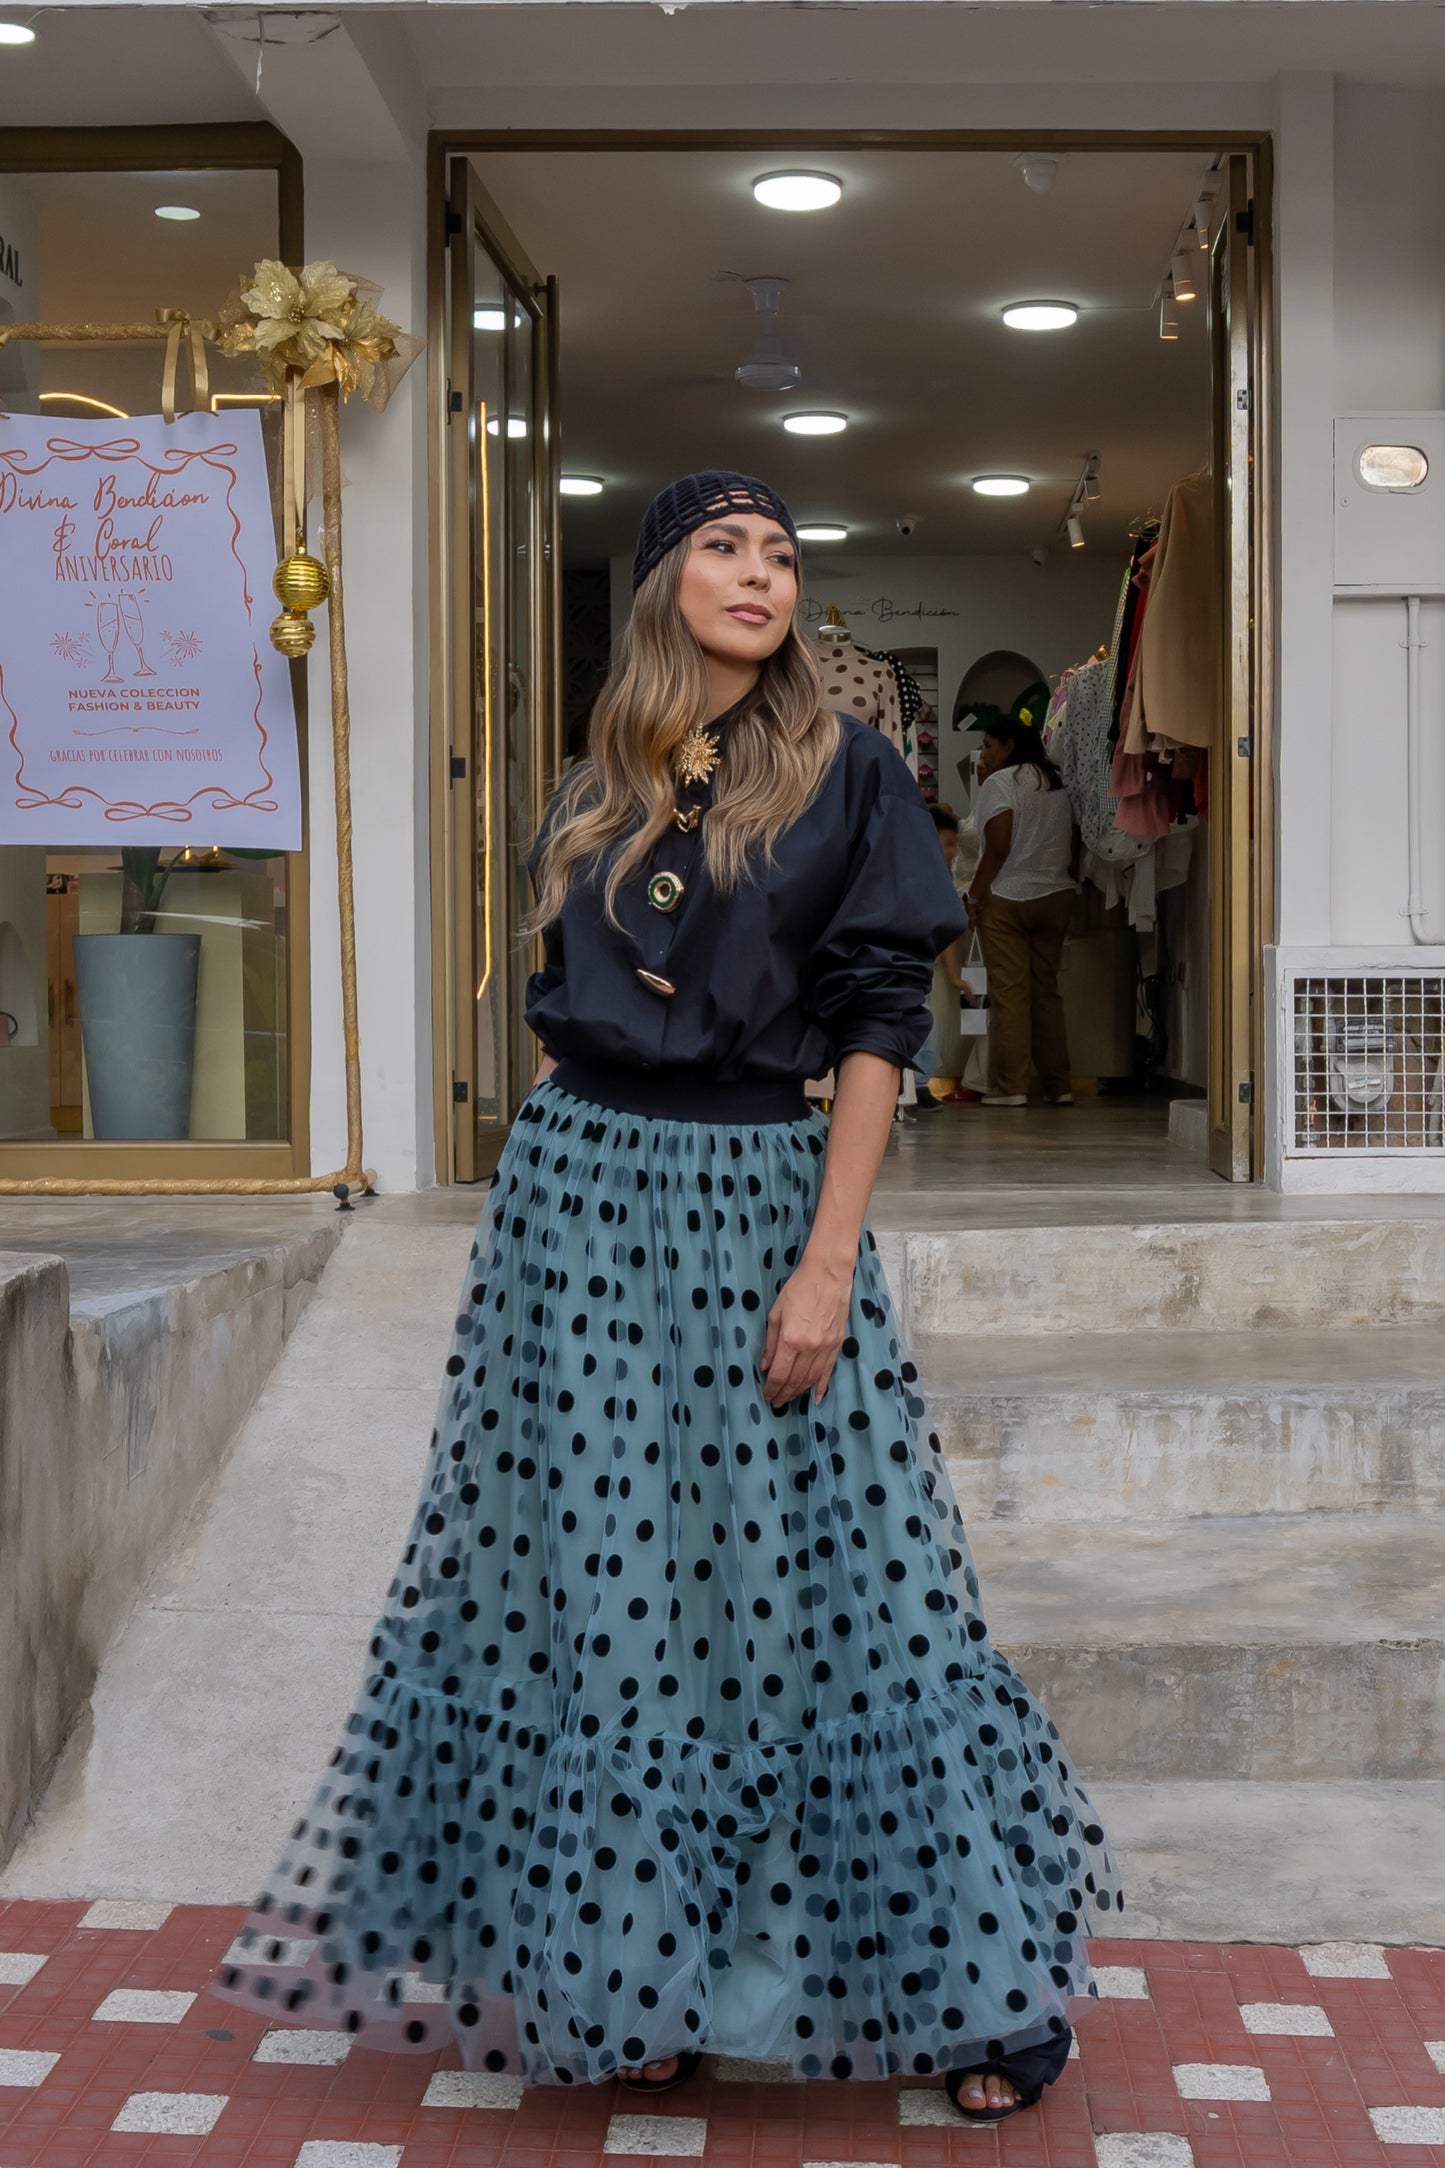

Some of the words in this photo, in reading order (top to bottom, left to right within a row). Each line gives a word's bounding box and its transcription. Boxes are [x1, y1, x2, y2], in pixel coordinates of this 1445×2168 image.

[0, 472, 78, 513] Divina
[95, 515, 163, 560] Coral
[55, 554, 173, 582] ANIVERSARIO
[68, 688, 117, 699] NUEVA
[120, 687, 200, 699] COLECCION
[68, 701, 129, 712] FASHION
[134, 701, 143, 711] &
[147, 700, 200, 711] BEAUTY
[50, 750, 86, 762] GRACIAS
[89, 749, 105, 761] POR
[108, 749, 150, 761] CELEBRAR
[152, 749, 173, 761] CON
[176, 748, 223, 762] NOSOTROS
